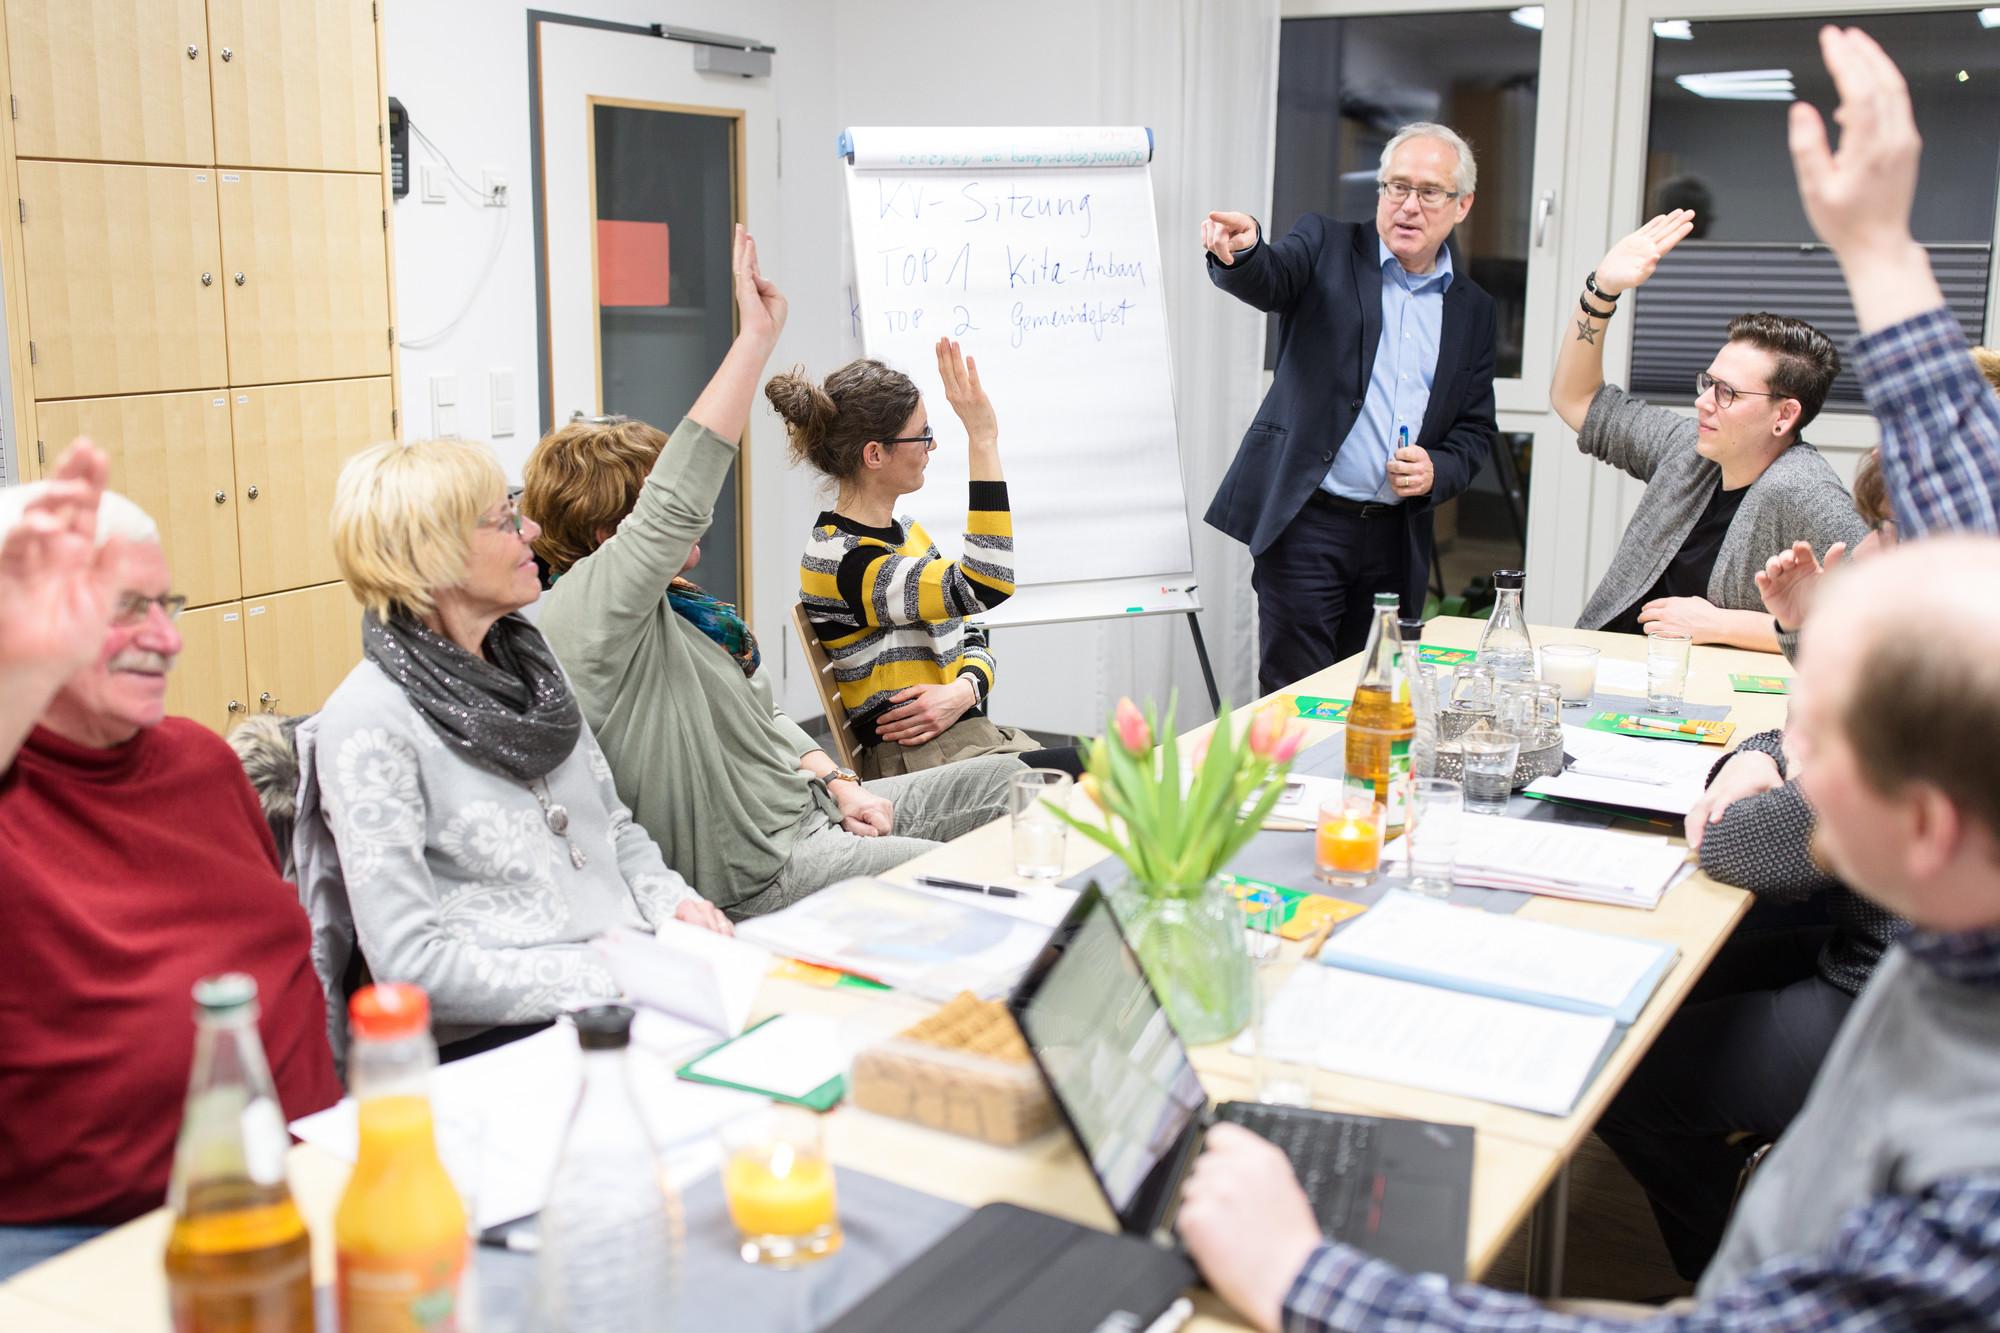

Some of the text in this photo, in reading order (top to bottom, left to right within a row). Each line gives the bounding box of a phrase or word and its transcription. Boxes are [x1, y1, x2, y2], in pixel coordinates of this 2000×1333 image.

[877, 246, 937, 287] TOP
[945, 242, 970, 291] 1
[884, 298, 1137, 349] TOP 2 Gemeindefest
